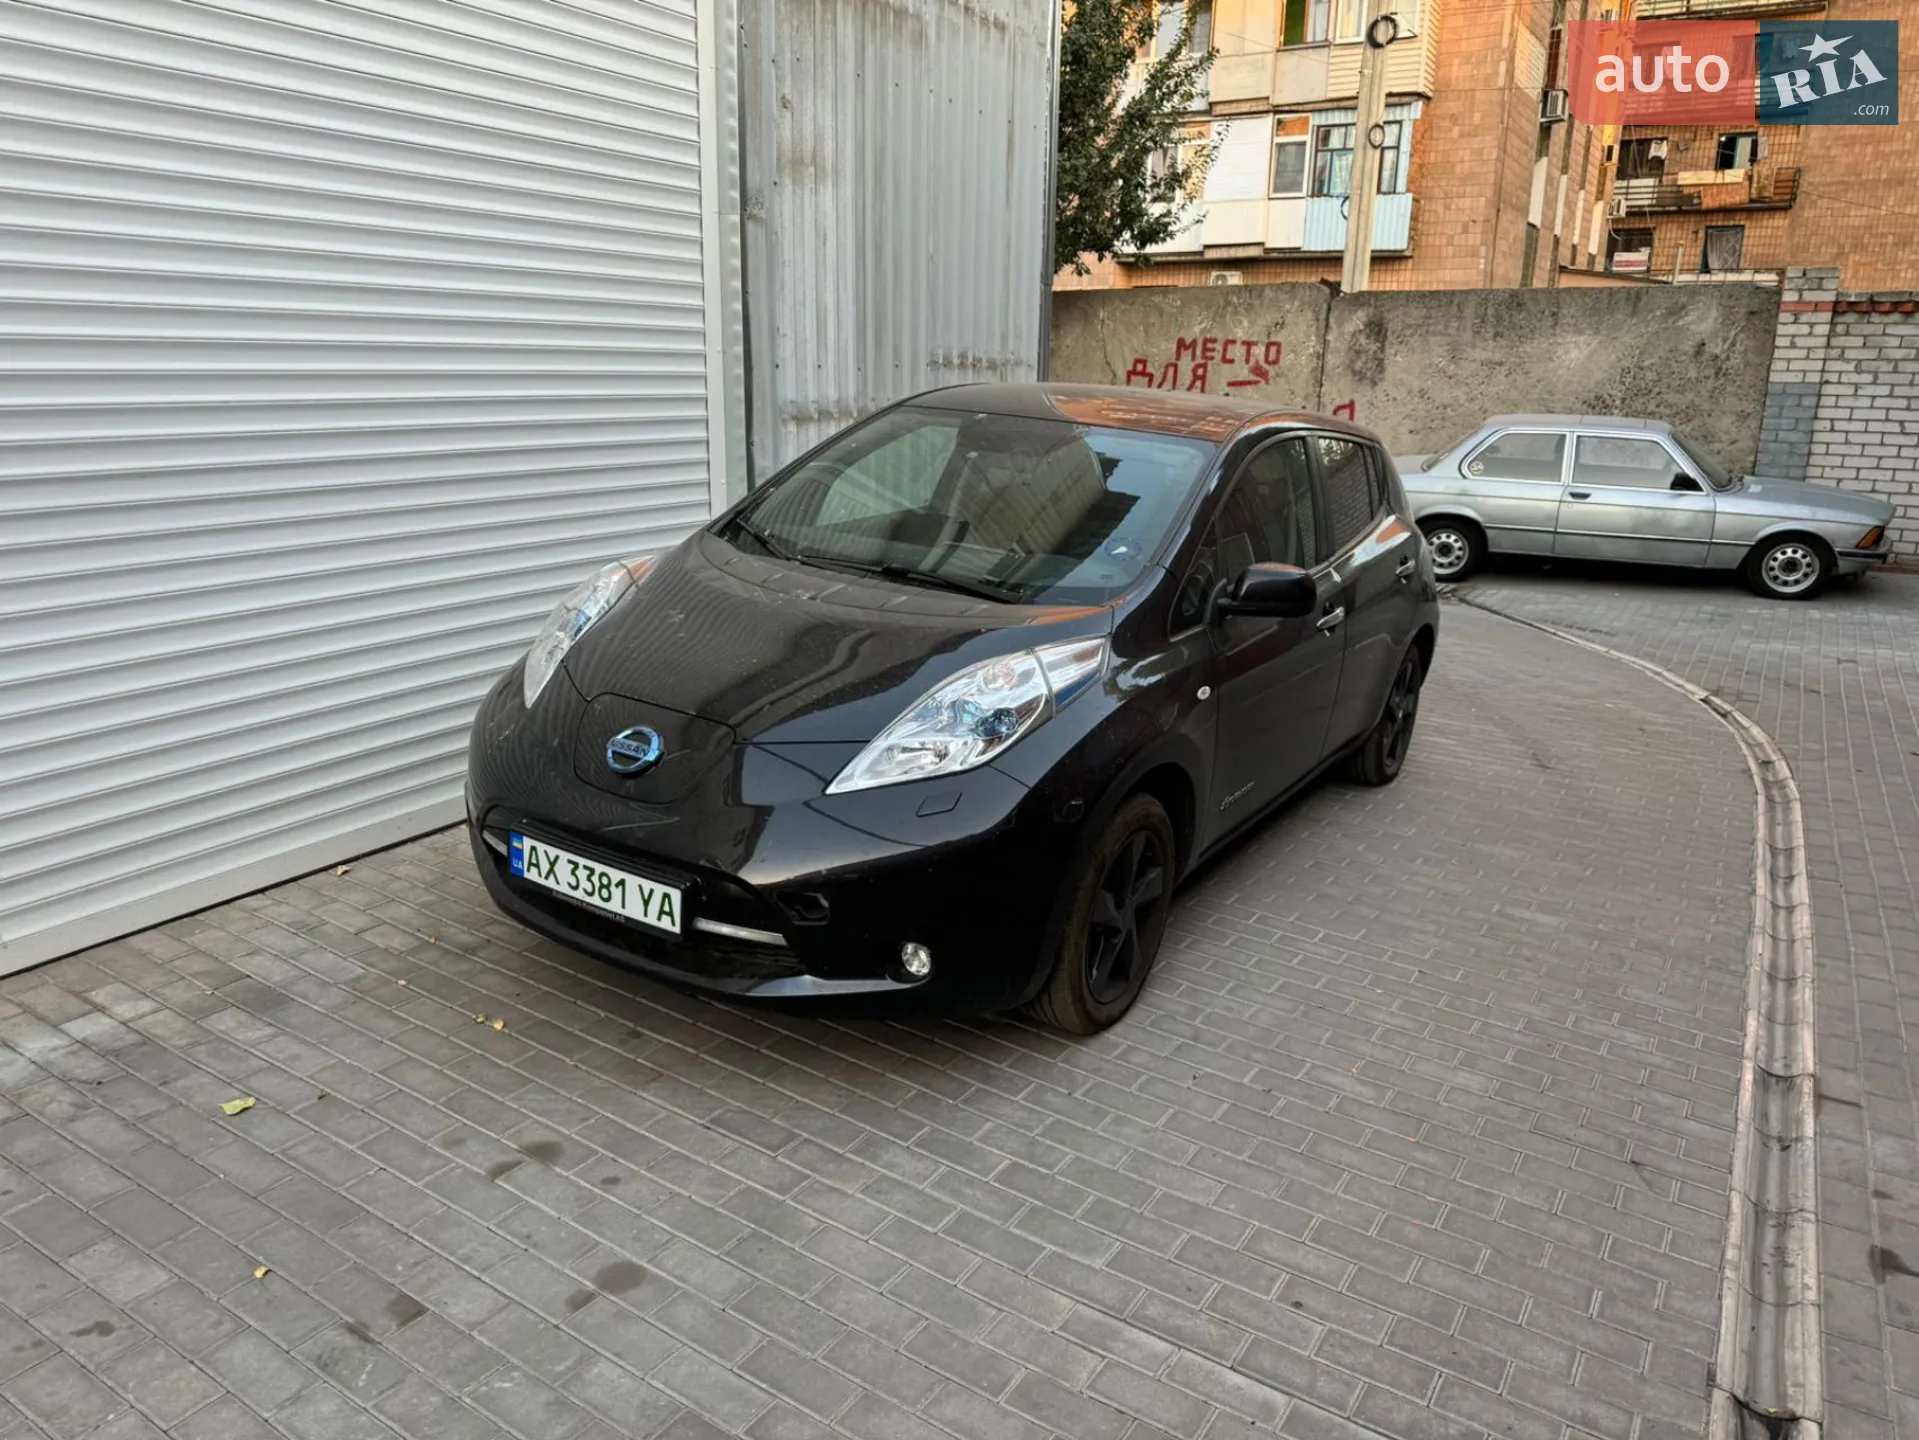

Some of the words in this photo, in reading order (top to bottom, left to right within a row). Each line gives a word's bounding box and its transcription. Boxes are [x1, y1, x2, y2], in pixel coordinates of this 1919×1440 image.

[1174, 336, 1283, 366] МЕСТО
[1126, 358, 1209, 393] ДЛЯ
[611, 738, 650, 757] NISSAN
[512, 857, 524, 870] UA
[526, 845, 560, 886] AX
[566, 858, 627, 910] 3381
[637, 883, 677, 928] YA
